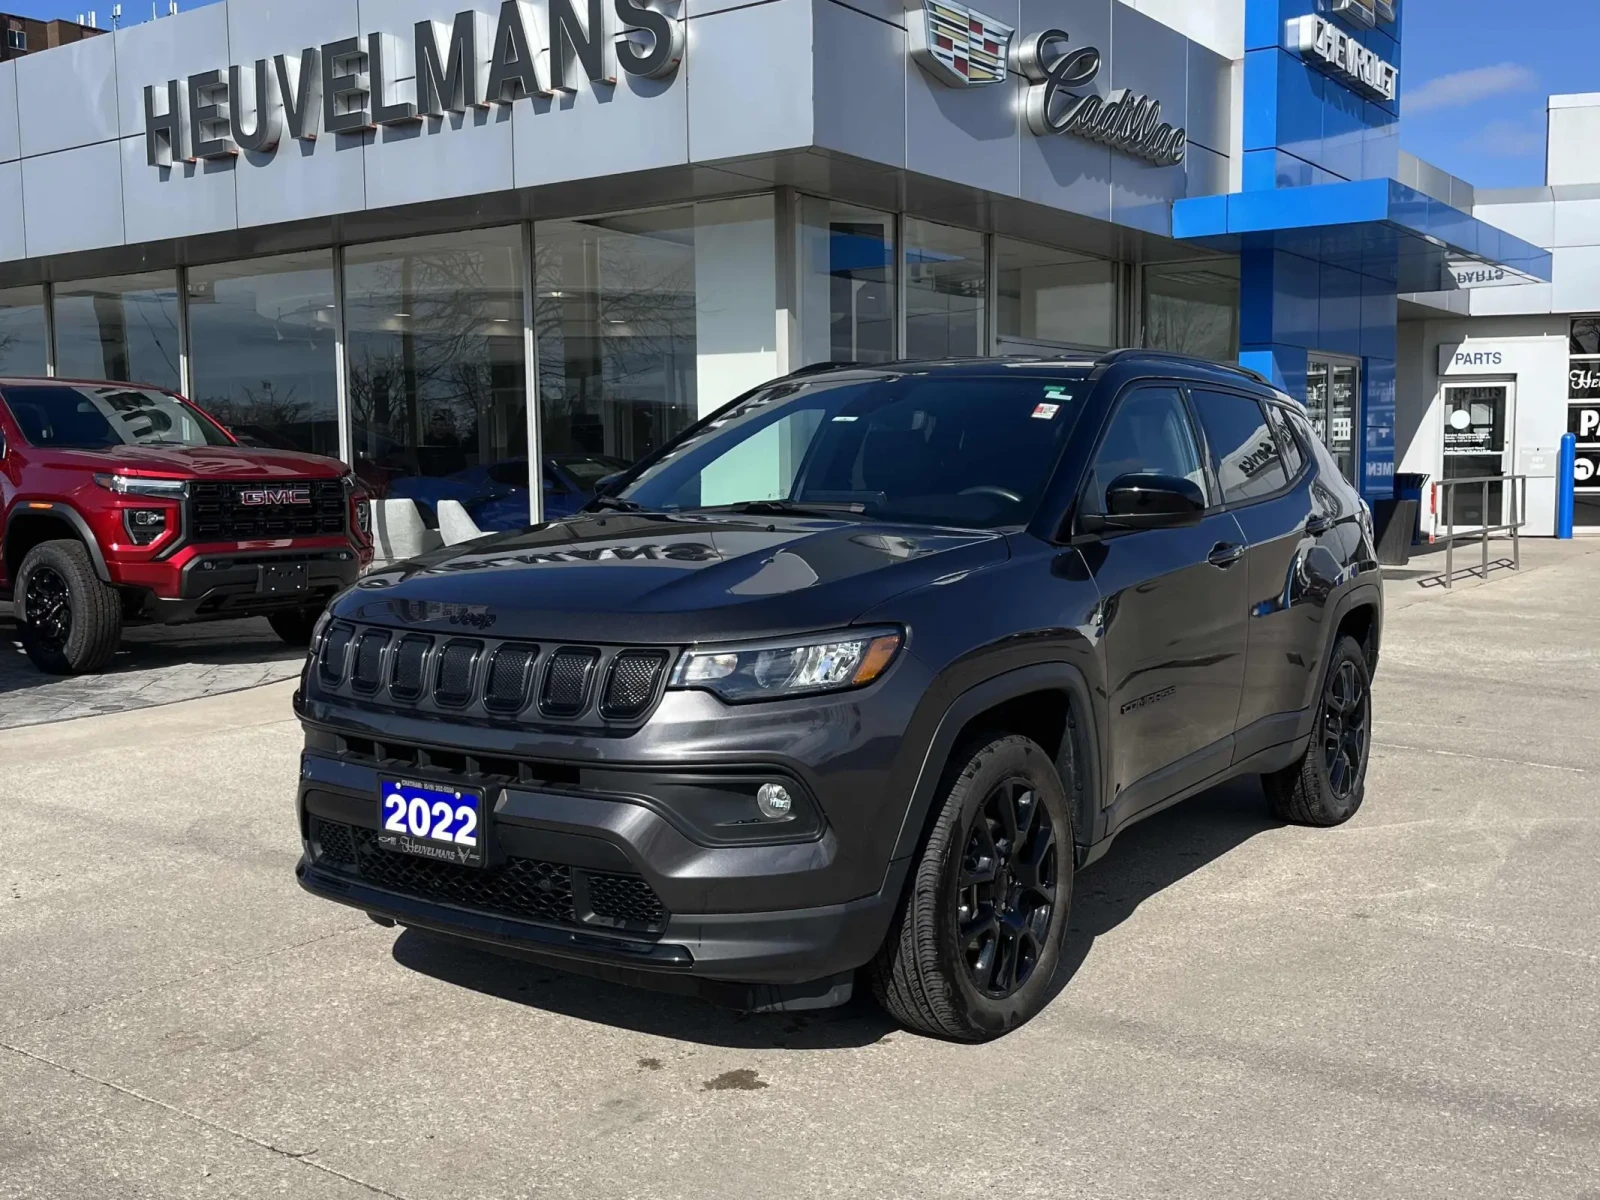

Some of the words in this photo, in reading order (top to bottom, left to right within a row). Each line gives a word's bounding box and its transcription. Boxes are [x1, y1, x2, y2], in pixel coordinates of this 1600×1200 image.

[143, 0, 680, 167] HEUVELMANS
[1021, 28, 1186, 167] Cadillac
[1455, 351, 1502, 365] PARTS
[241, 489, 311, 505] GMC
[449, 607, 496, 630] Jeep
[385, 793, 478, 847] 2022
